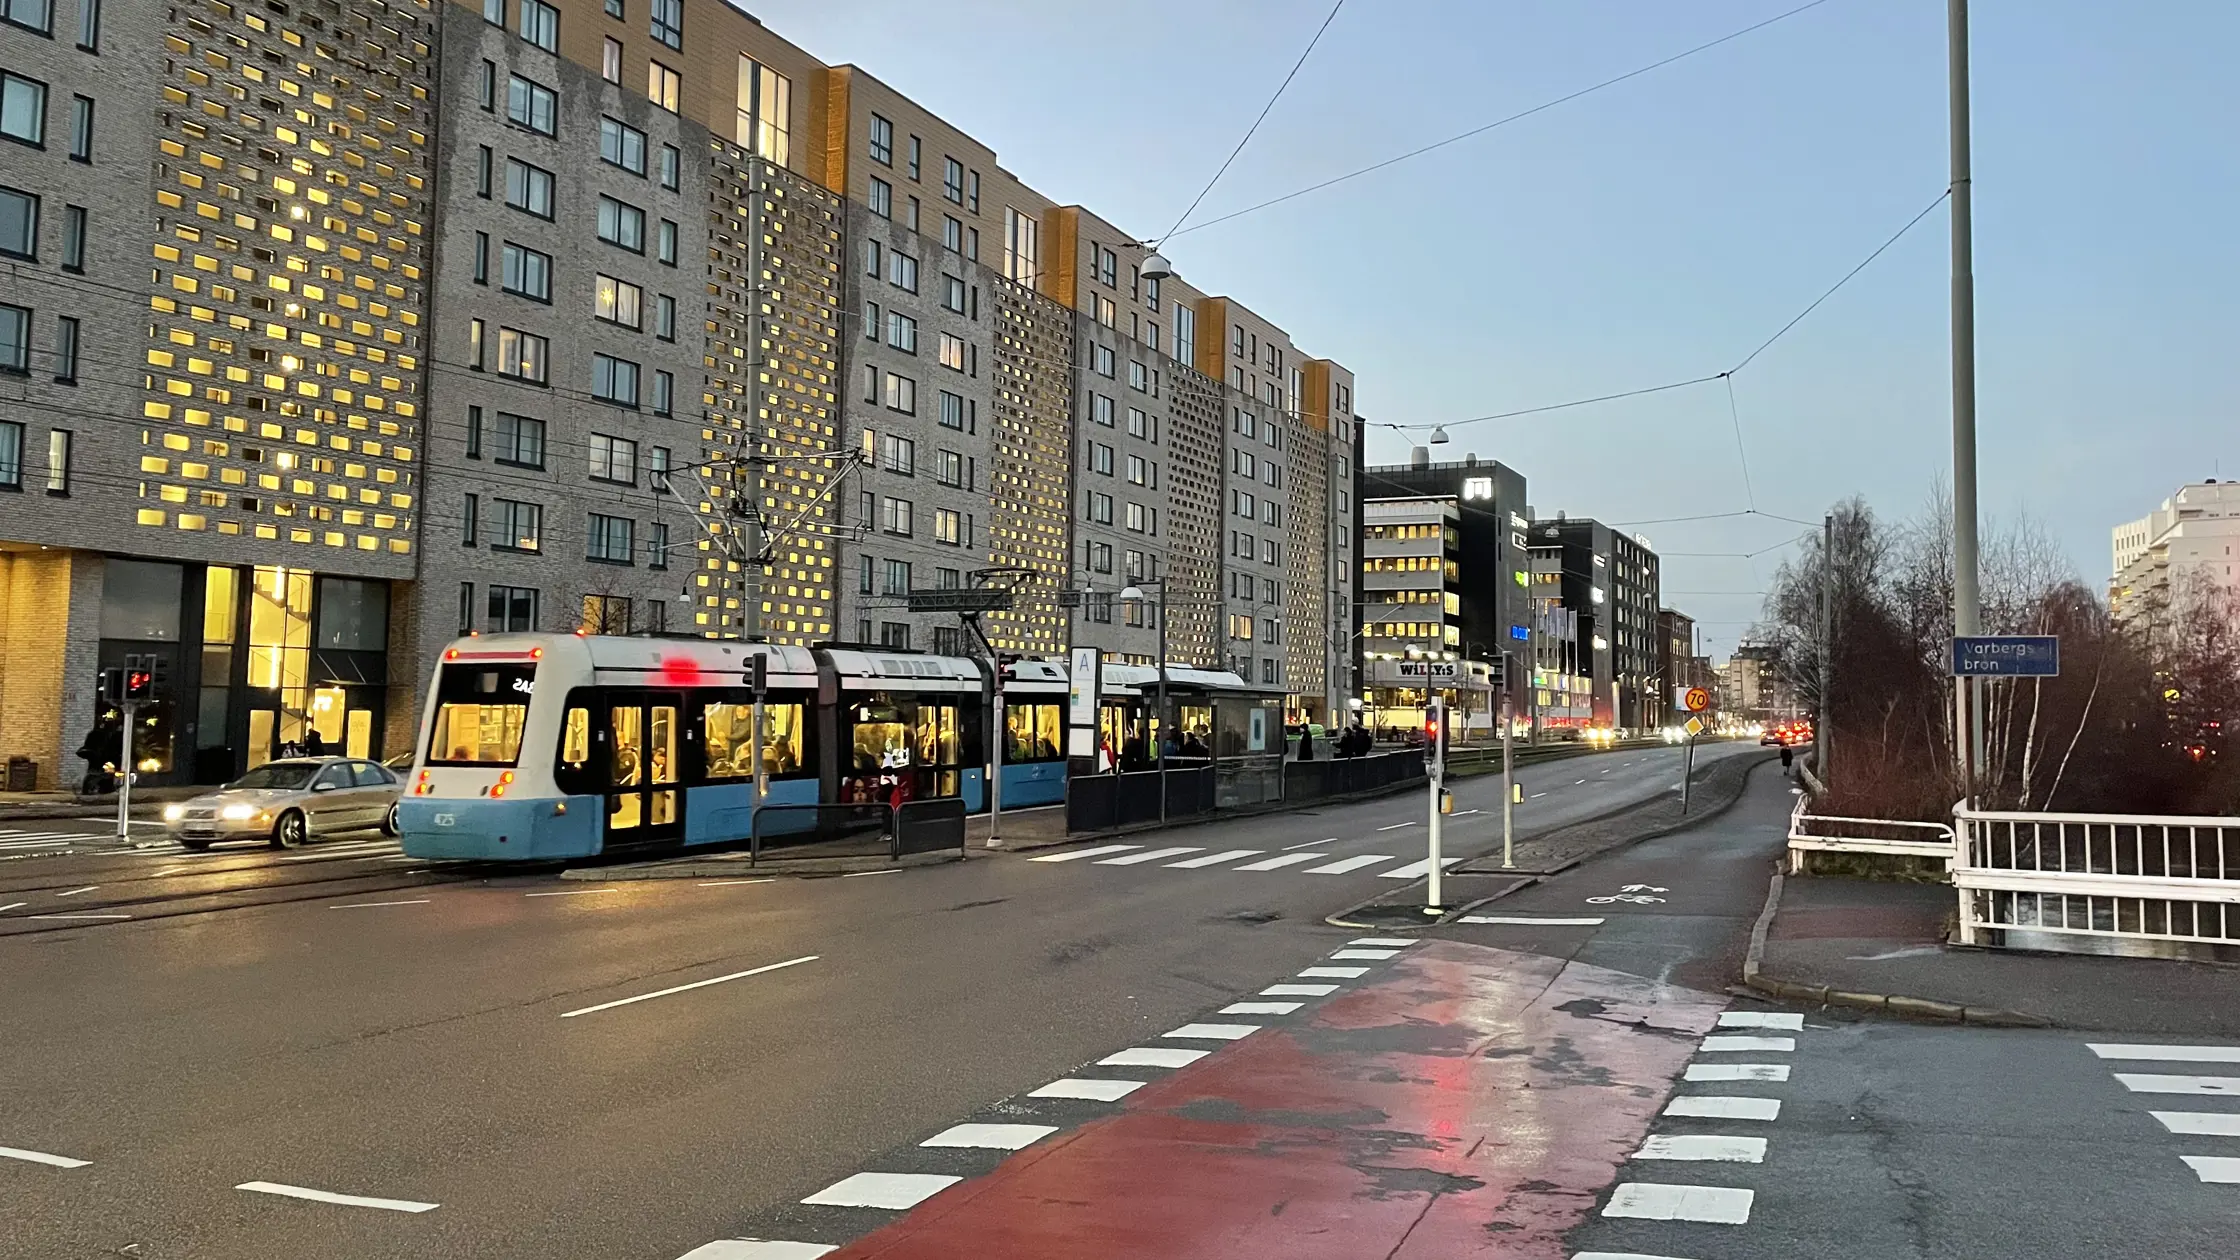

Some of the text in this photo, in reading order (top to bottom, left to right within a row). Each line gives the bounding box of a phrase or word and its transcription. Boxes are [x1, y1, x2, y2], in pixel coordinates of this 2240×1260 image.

[1079, 653, 1089, 671] A
[1964, 658, 1999, 671] bron
[1690, 693, 1706, 706] 70
